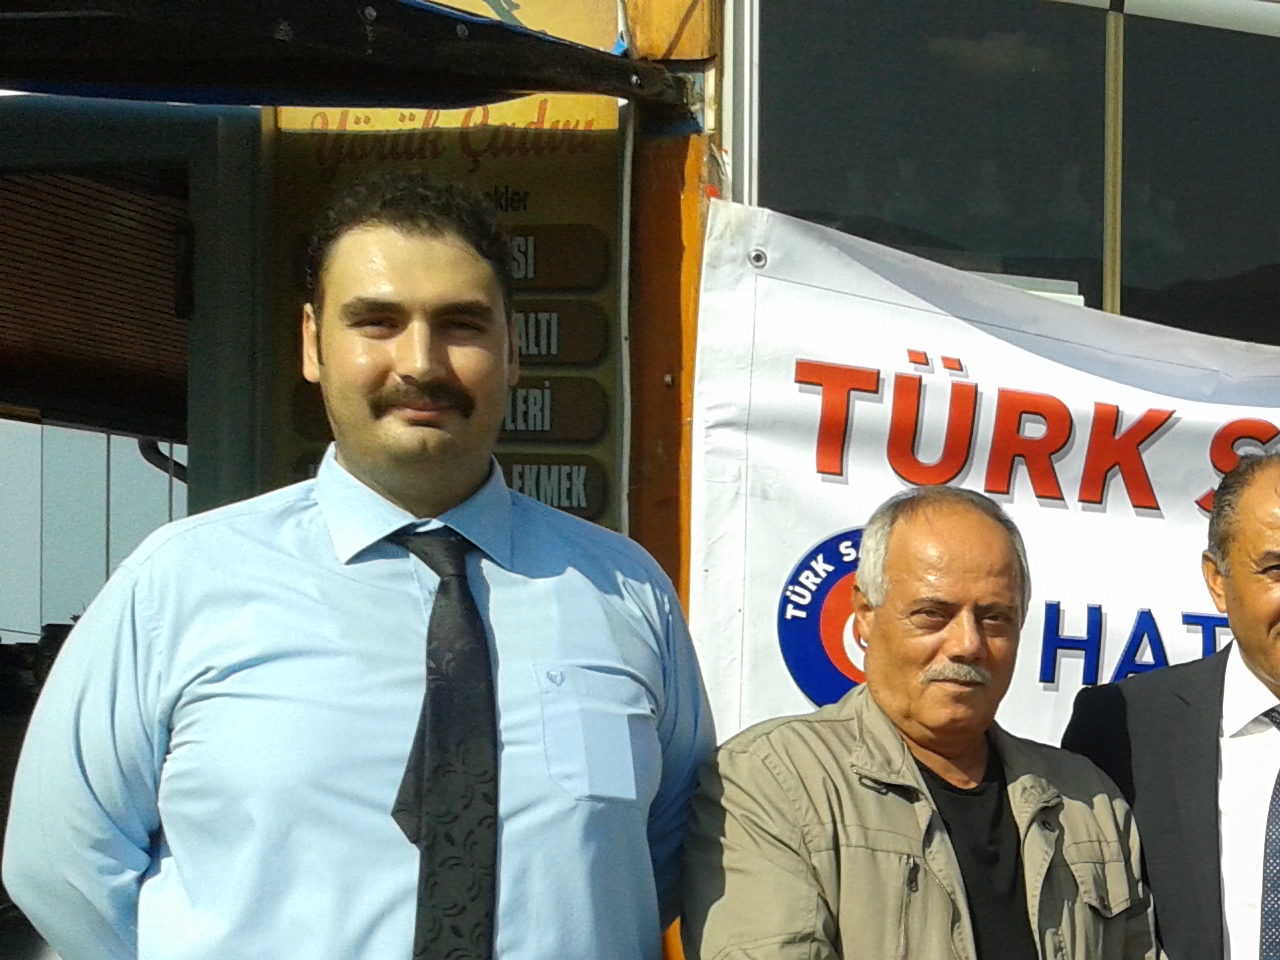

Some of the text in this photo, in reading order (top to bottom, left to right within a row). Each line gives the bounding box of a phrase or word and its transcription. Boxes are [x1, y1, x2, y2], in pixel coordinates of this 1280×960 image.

[515, 312, 559, 355] ALTI
[504, 381, 551, 431] LERİ
[794, 348, 1176, 511] TÜRK
[512, 465, 588, 508] EKMEK
[785, 552, 836, 620] TÜRK
